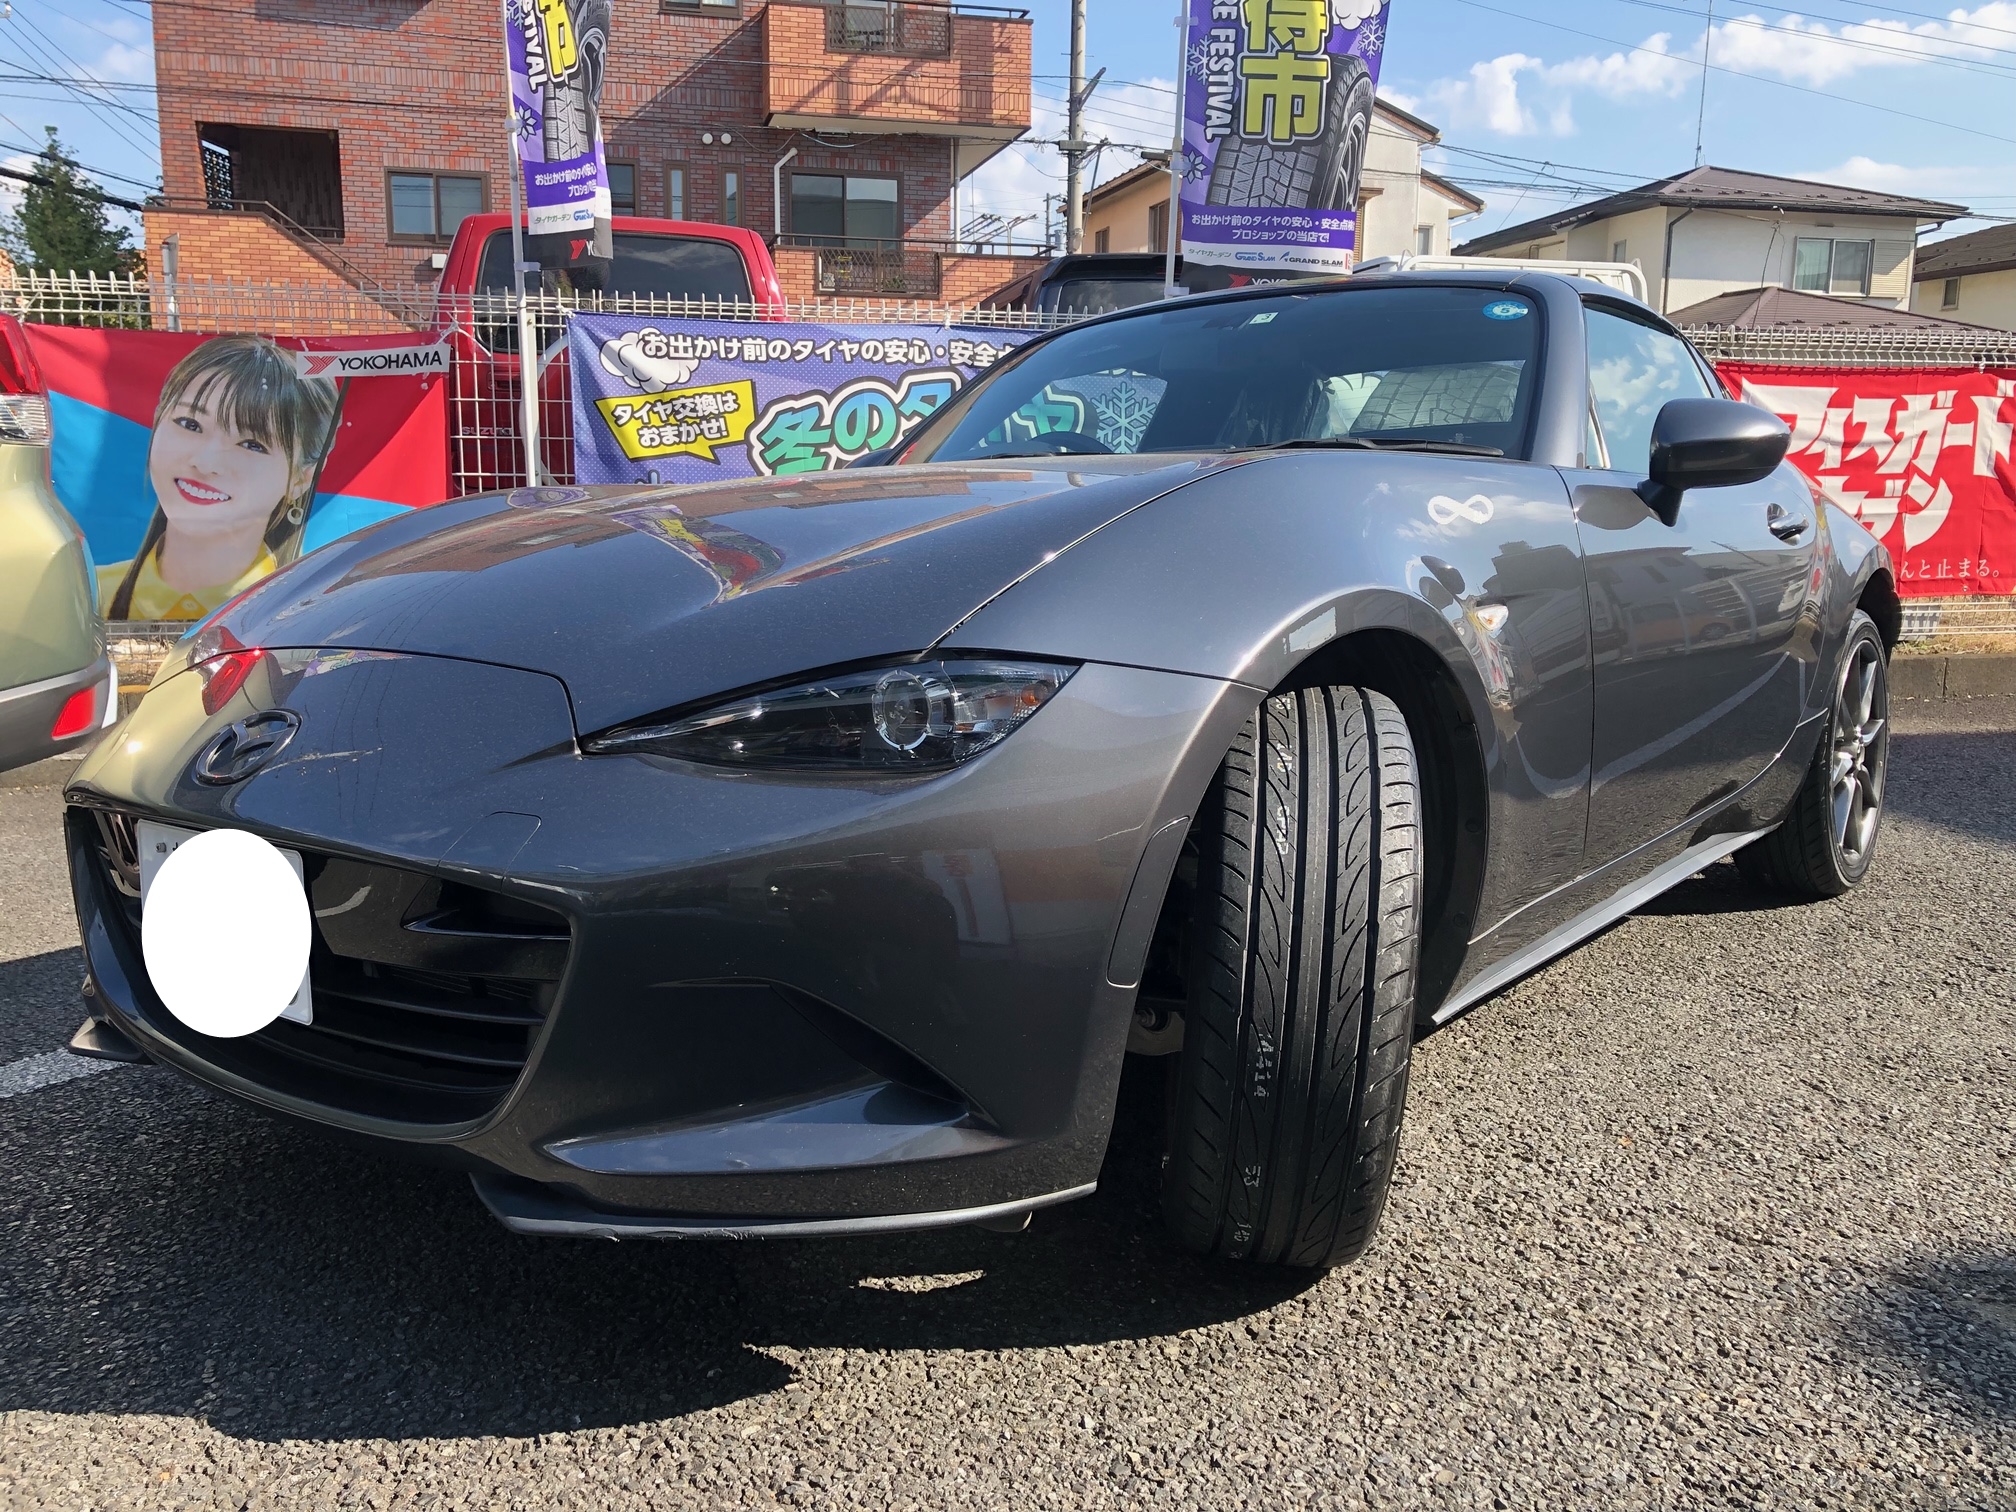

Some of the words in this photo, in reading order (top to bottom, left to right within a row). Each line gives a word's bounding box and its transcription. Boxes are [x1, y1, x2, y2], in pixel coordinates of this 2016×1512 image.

[1205, 28, 1236, 140] FESTIVAL
[1188, 248, 1232, 259] タイヤガーデン
[1289, 257, 1320, 265] GRAND
[338, 351, 443, 371] YOKOHAMA
[612, 391, 740, 426] タイヤ交換は
[462, 426, 514, 435] SUZUKI
[638, 418, 728, 448] おまかせ!
